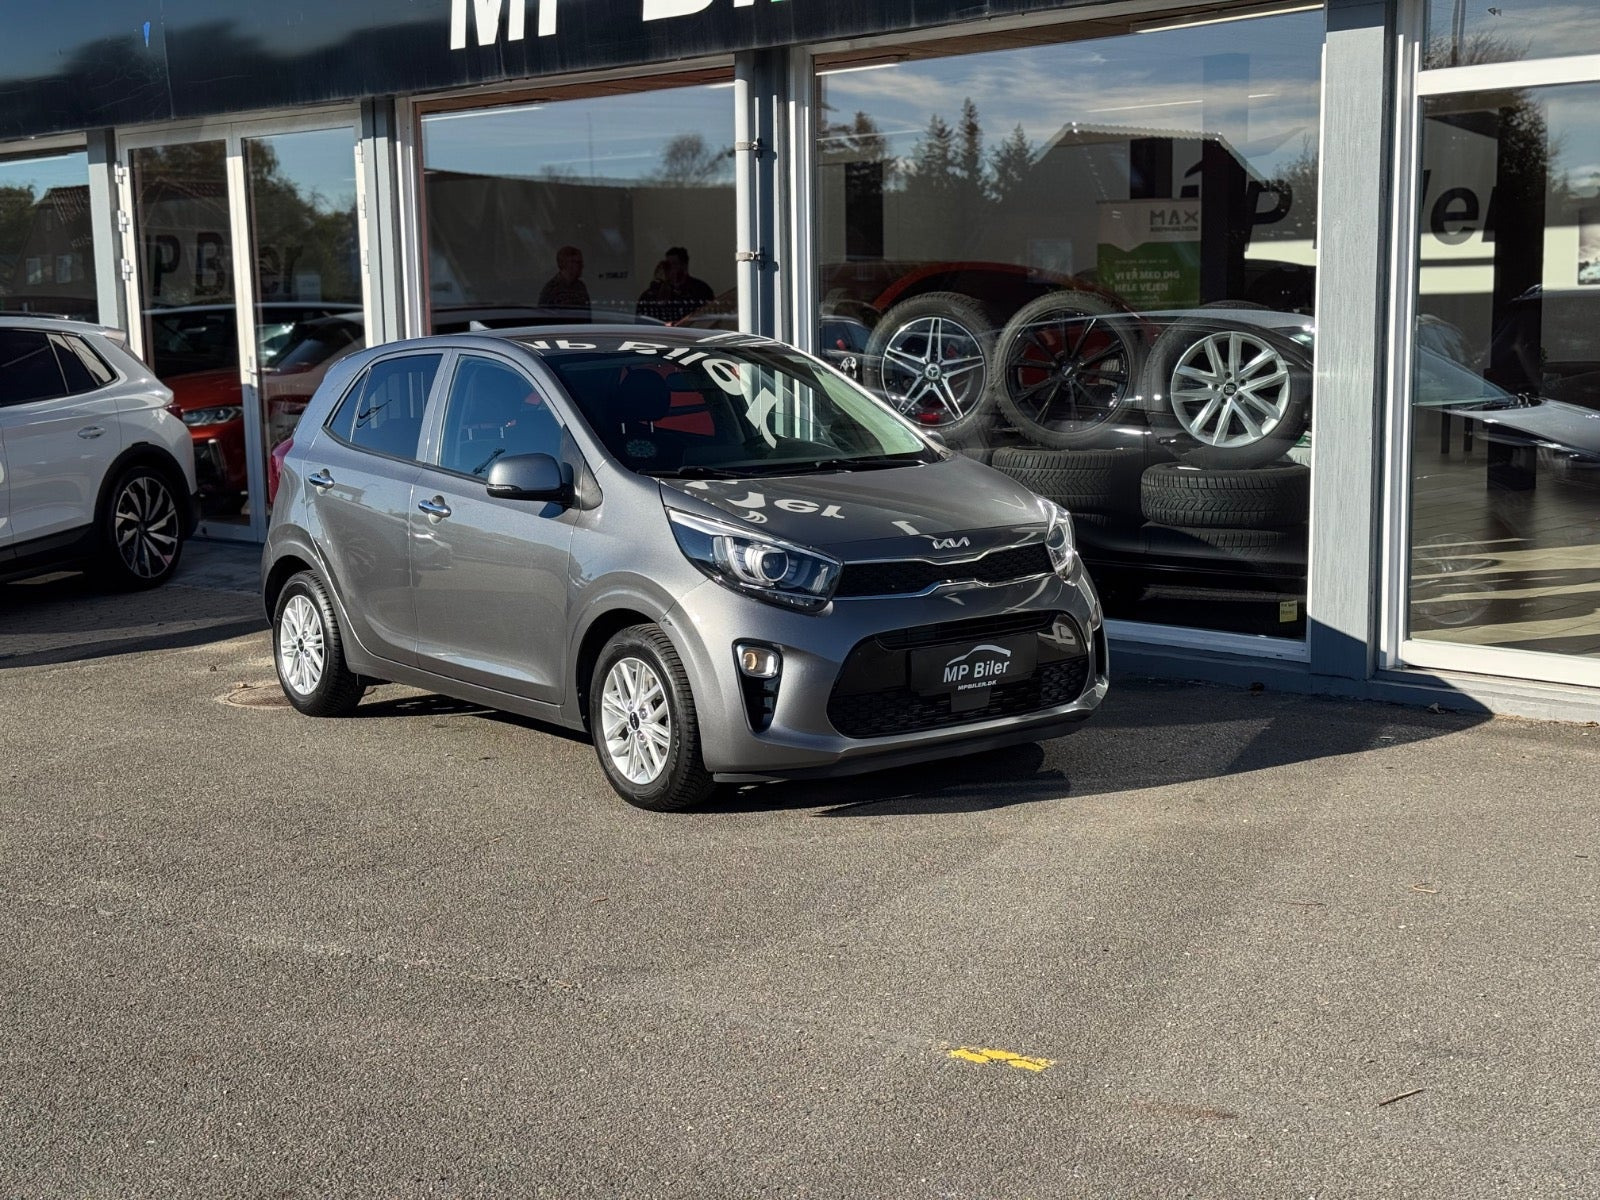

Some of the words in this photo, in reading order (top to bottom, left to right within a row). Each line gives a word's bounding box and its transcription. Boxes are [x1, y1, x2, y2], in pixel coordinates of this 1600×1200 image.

[1149, 209, 1199, 226] MAX
[1114, 283, 1137, 292] HELE
[1139, 282, 1169, 292] VEJEN
[943, 664, 970, 683] MP
[973, 660, 1010, 679] Biler
[957, 679, 998, 691] MPBILER.DK
